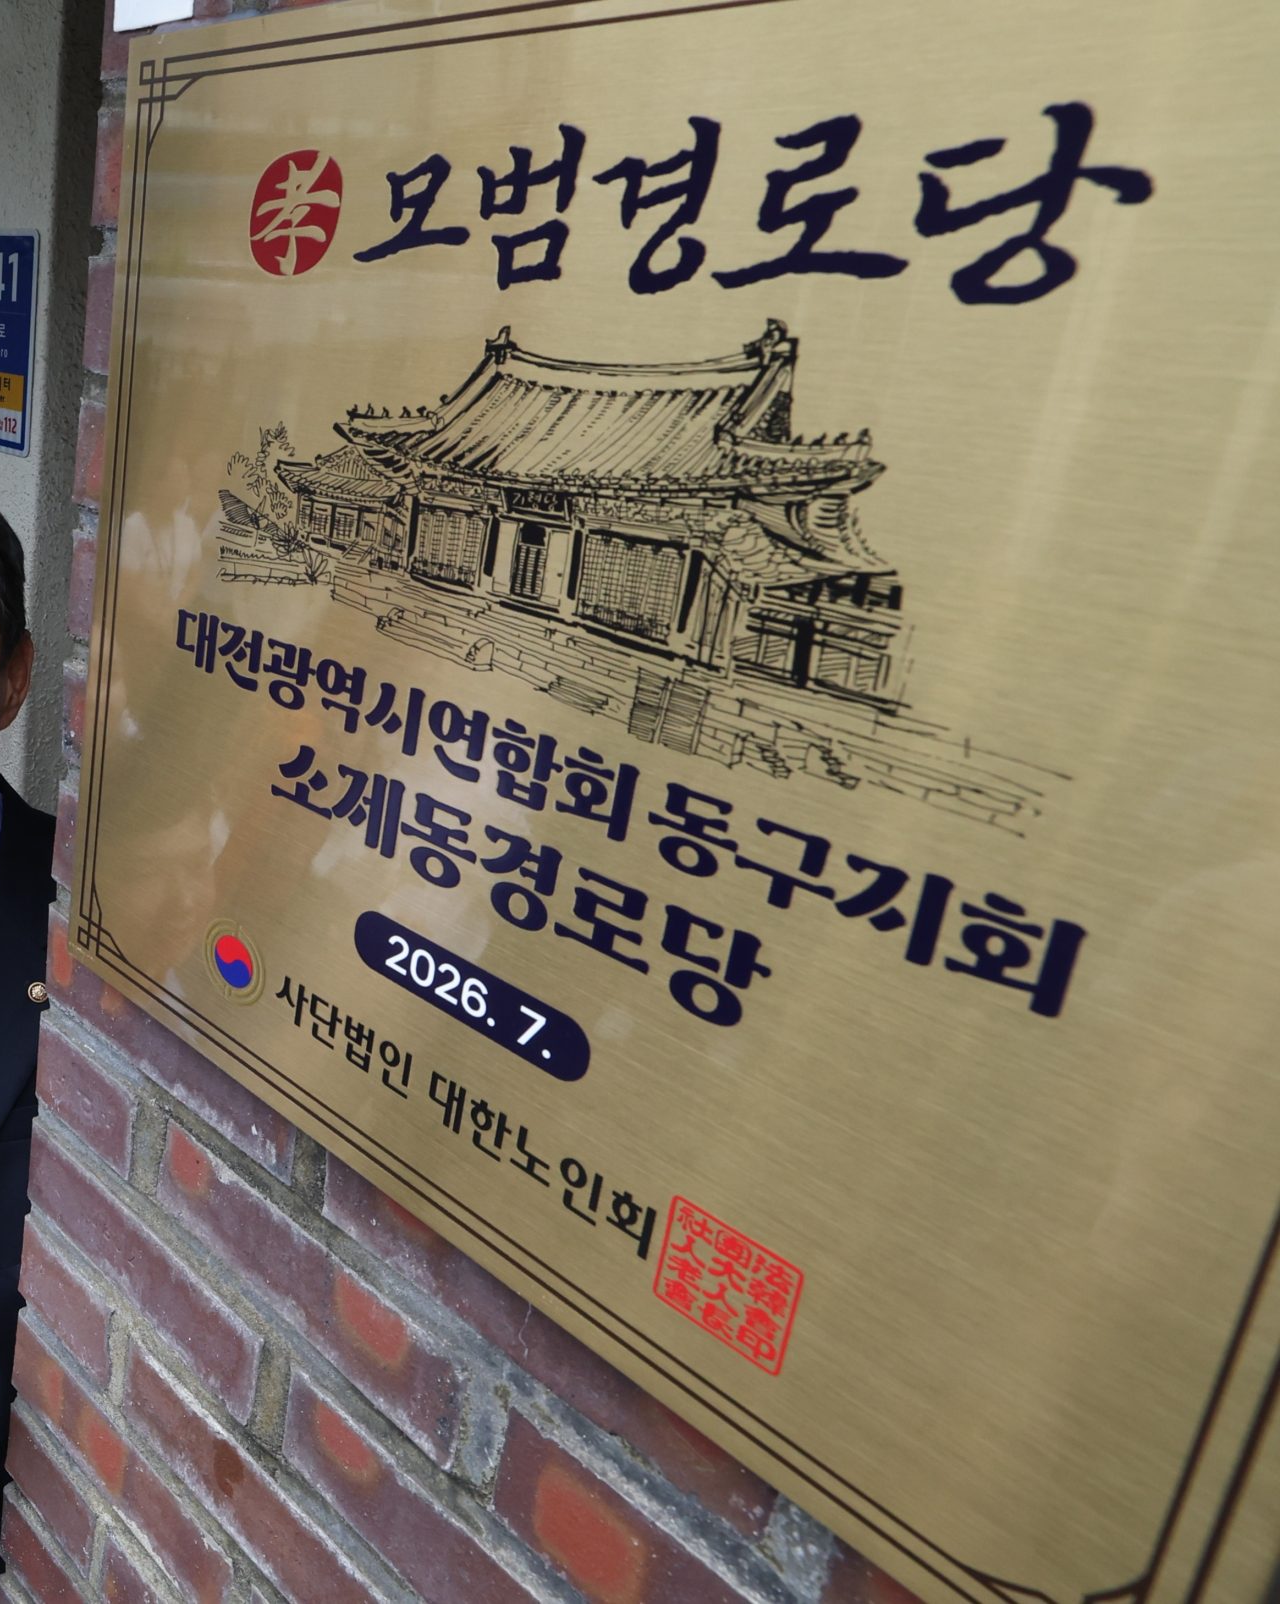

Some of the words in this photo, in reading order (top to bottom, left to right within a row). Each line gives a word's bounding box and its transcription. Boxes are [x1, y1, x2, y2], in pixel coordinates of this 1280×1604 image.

[353, 101, 1154, 304] 모범경로당
[4, 416, 17, 434] 112
[271, 744, 772, 1027] 소제동경로당
[385, 935, 496, 1027] 2026.
[516, 1005, 552, 1059] 7.
[275, 975, 413, 1100] 사단법인
[428, 1070, 658, 1261] 대한노인회
